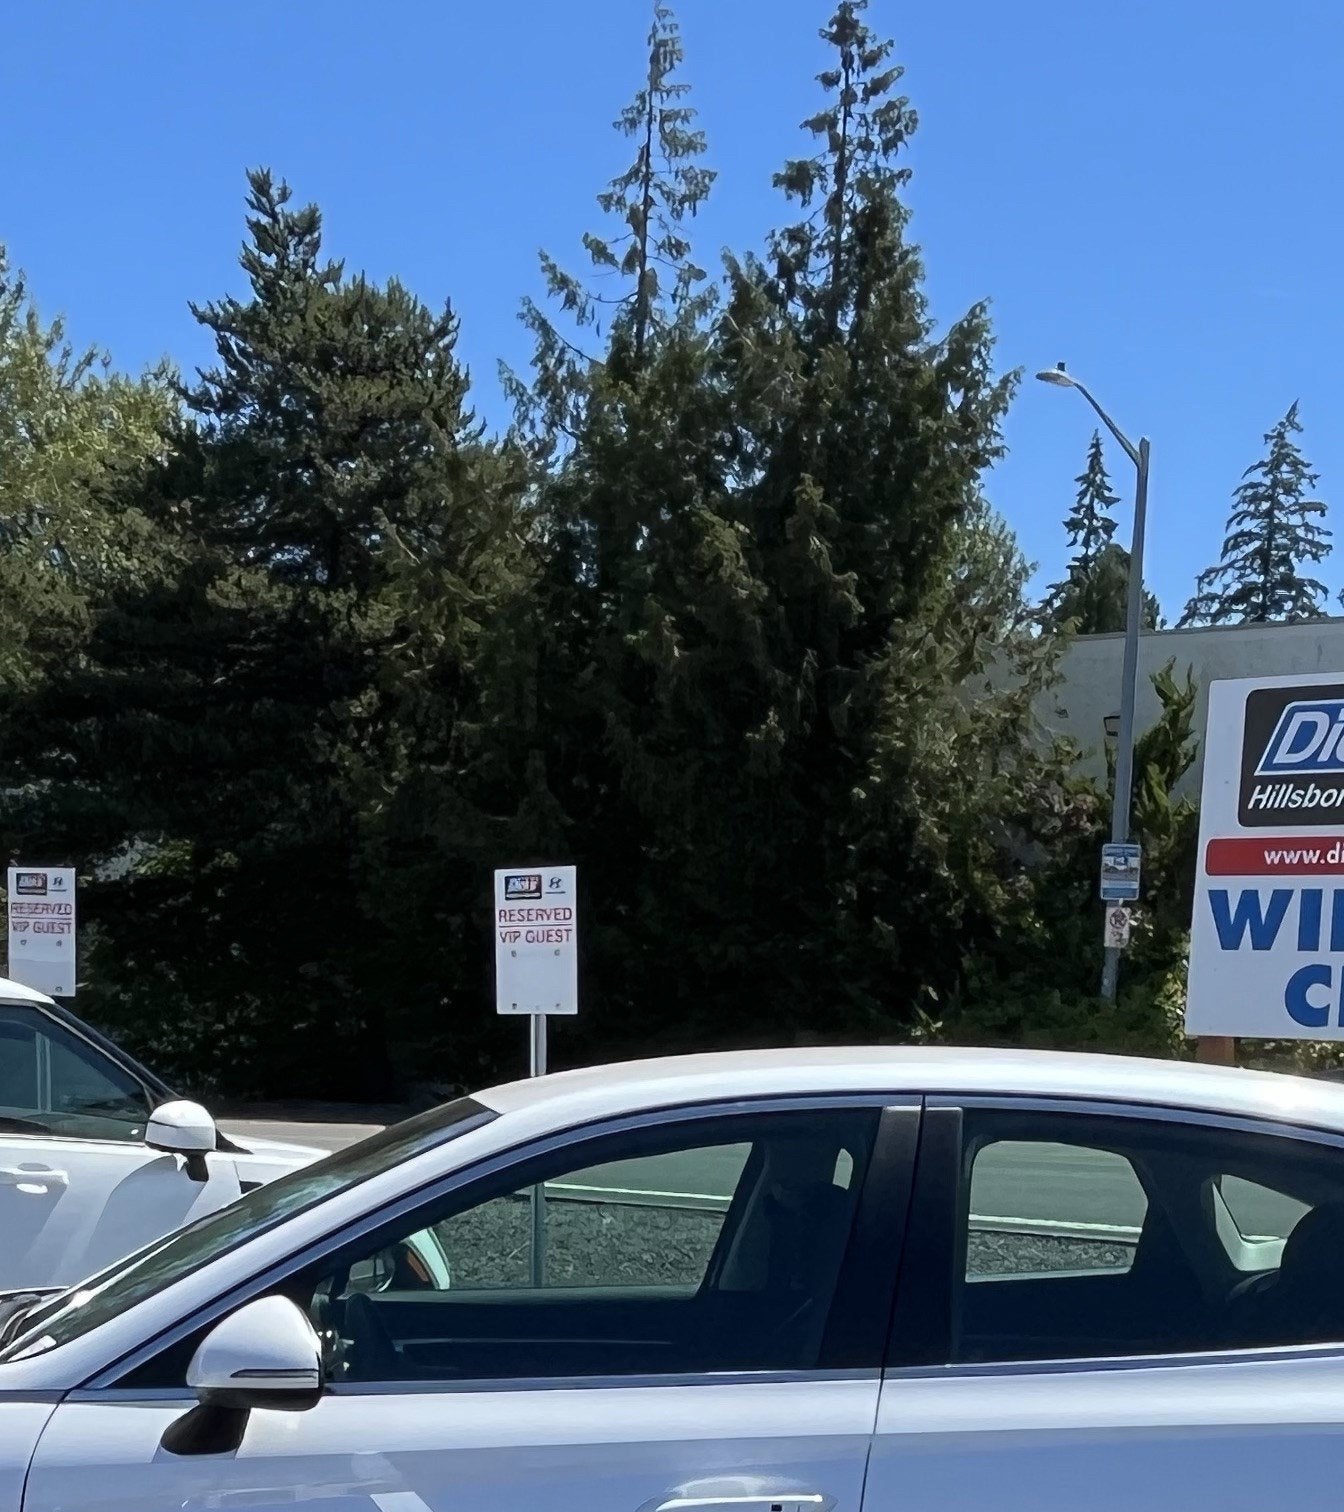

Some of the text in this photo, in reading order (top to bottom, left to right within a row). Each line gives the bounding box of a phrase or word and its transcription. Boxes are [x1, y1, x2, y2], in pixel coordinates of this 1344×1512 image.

[498, 908, 573, 922] RESERVED
[499, 929, 573, 943] VIP GUEST
